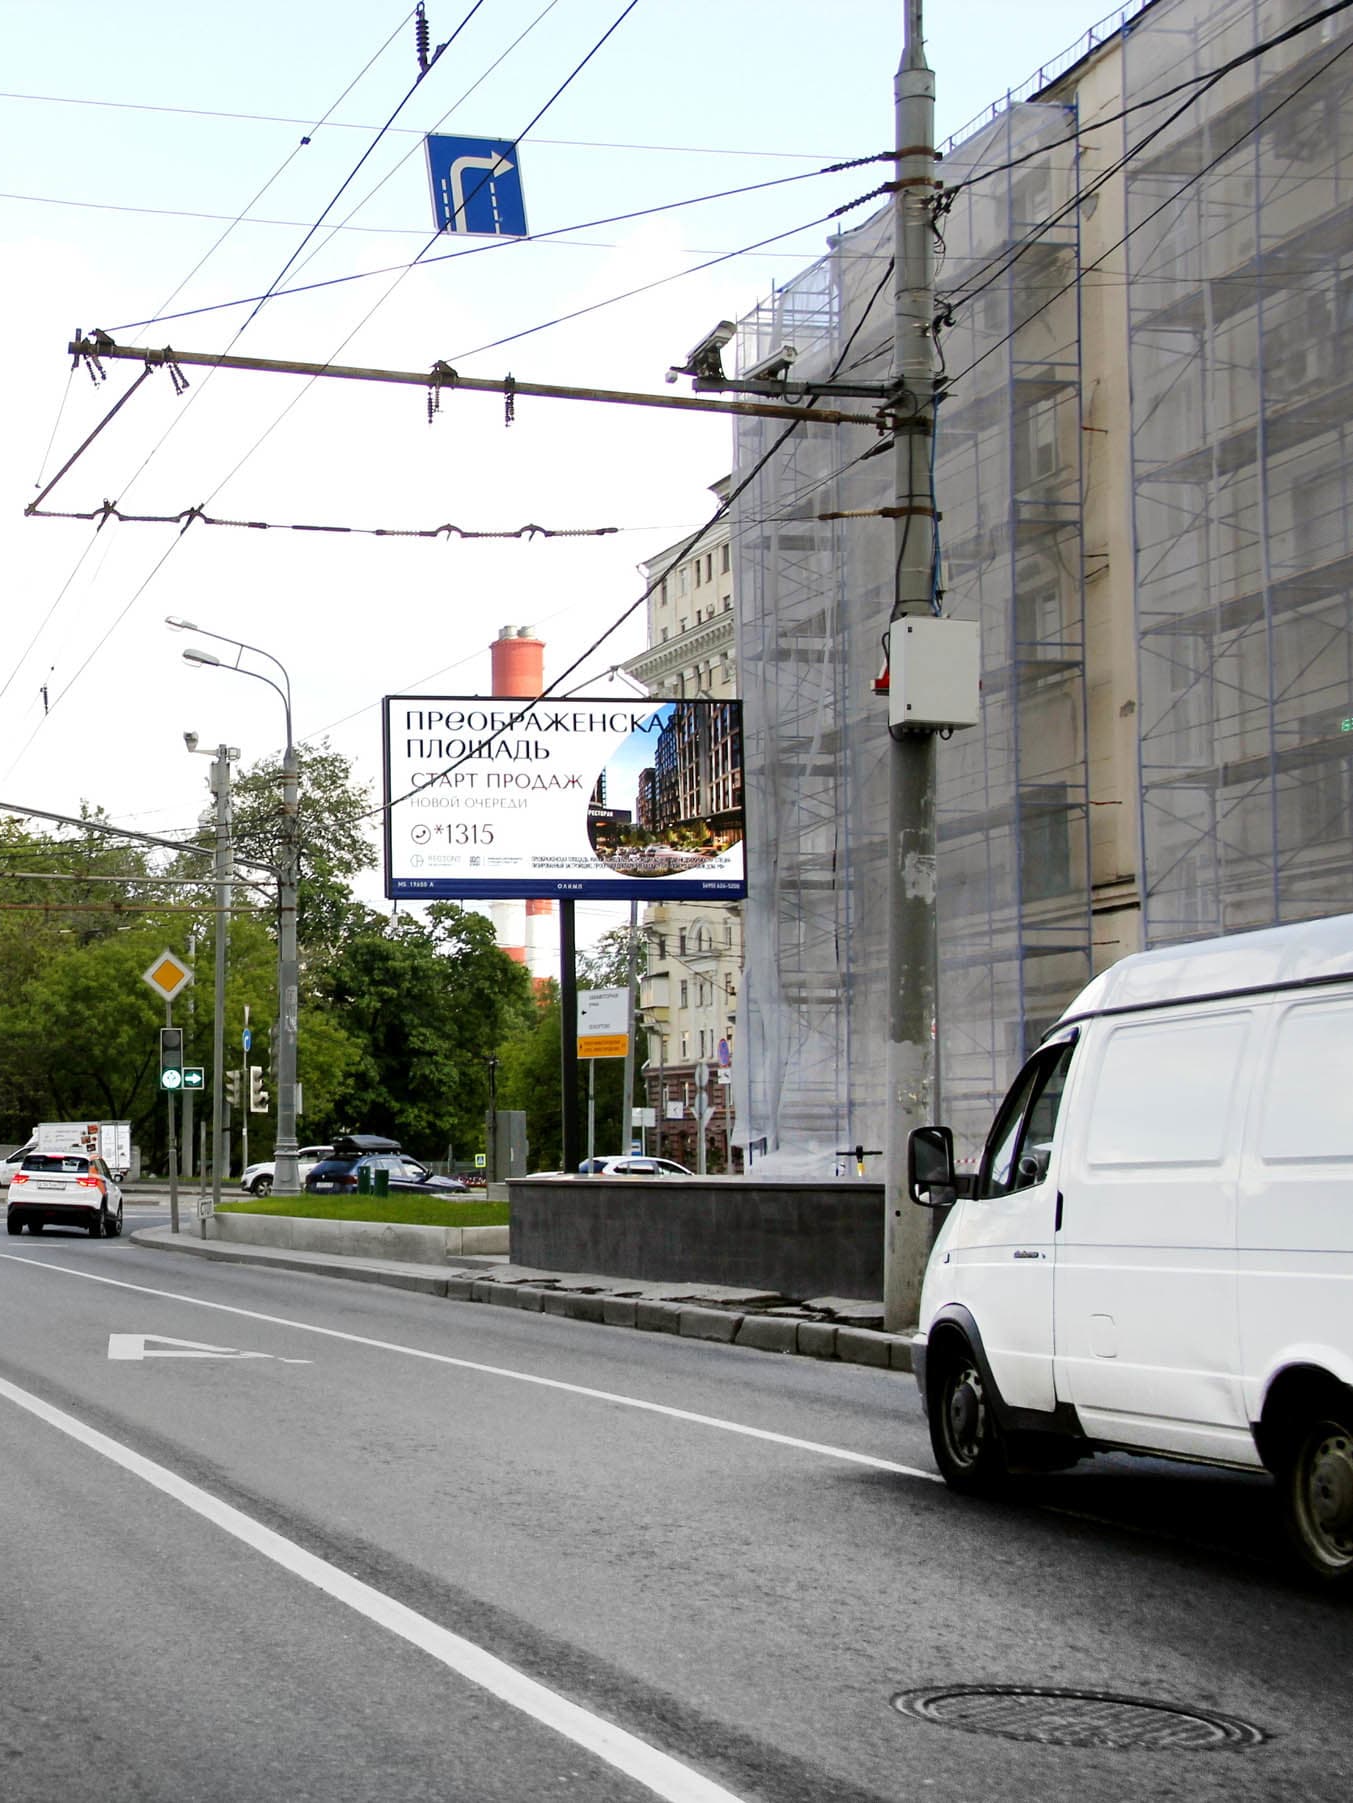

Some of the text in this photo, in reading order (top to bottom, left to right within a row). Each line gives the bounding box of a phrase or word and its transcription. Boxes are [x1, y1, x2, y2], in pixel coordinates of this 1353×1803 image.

[406, 739, 550, 762] ПЛОЩАДЬ
[411, 772, 584, 790] СТАРТ ПРОДАЖ
[410, 796, 528, 809] НОВОЙ ОЧЕРЕДИ
